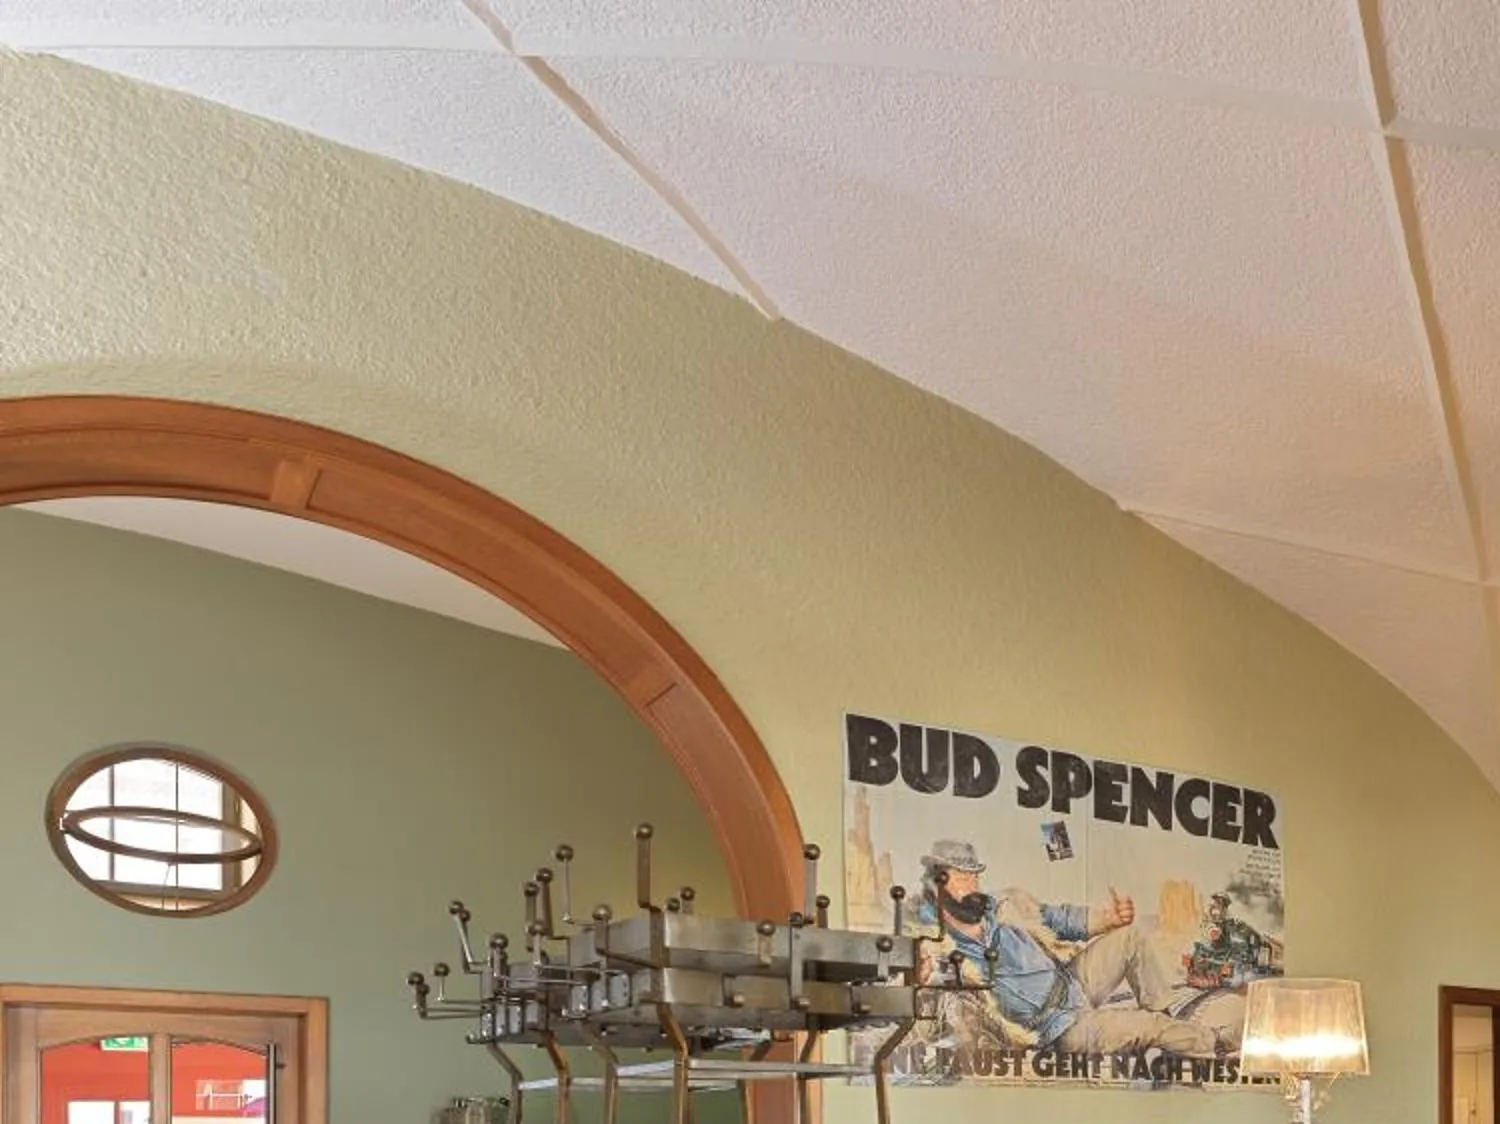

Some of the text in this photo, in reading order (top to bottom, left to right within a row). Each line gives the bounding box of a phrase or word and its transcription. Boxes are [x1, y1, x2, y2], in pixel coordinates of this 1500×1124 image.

[845, 713, 1279, 849] BUD SPENCER
[934, 1047, 1028, 1078] FAUST
[1031, 1049, 1104, 1079] GEHT
[1111, 1049, 1183, 1082] NACH
[1192, 1056, 1281, 1085] WES
